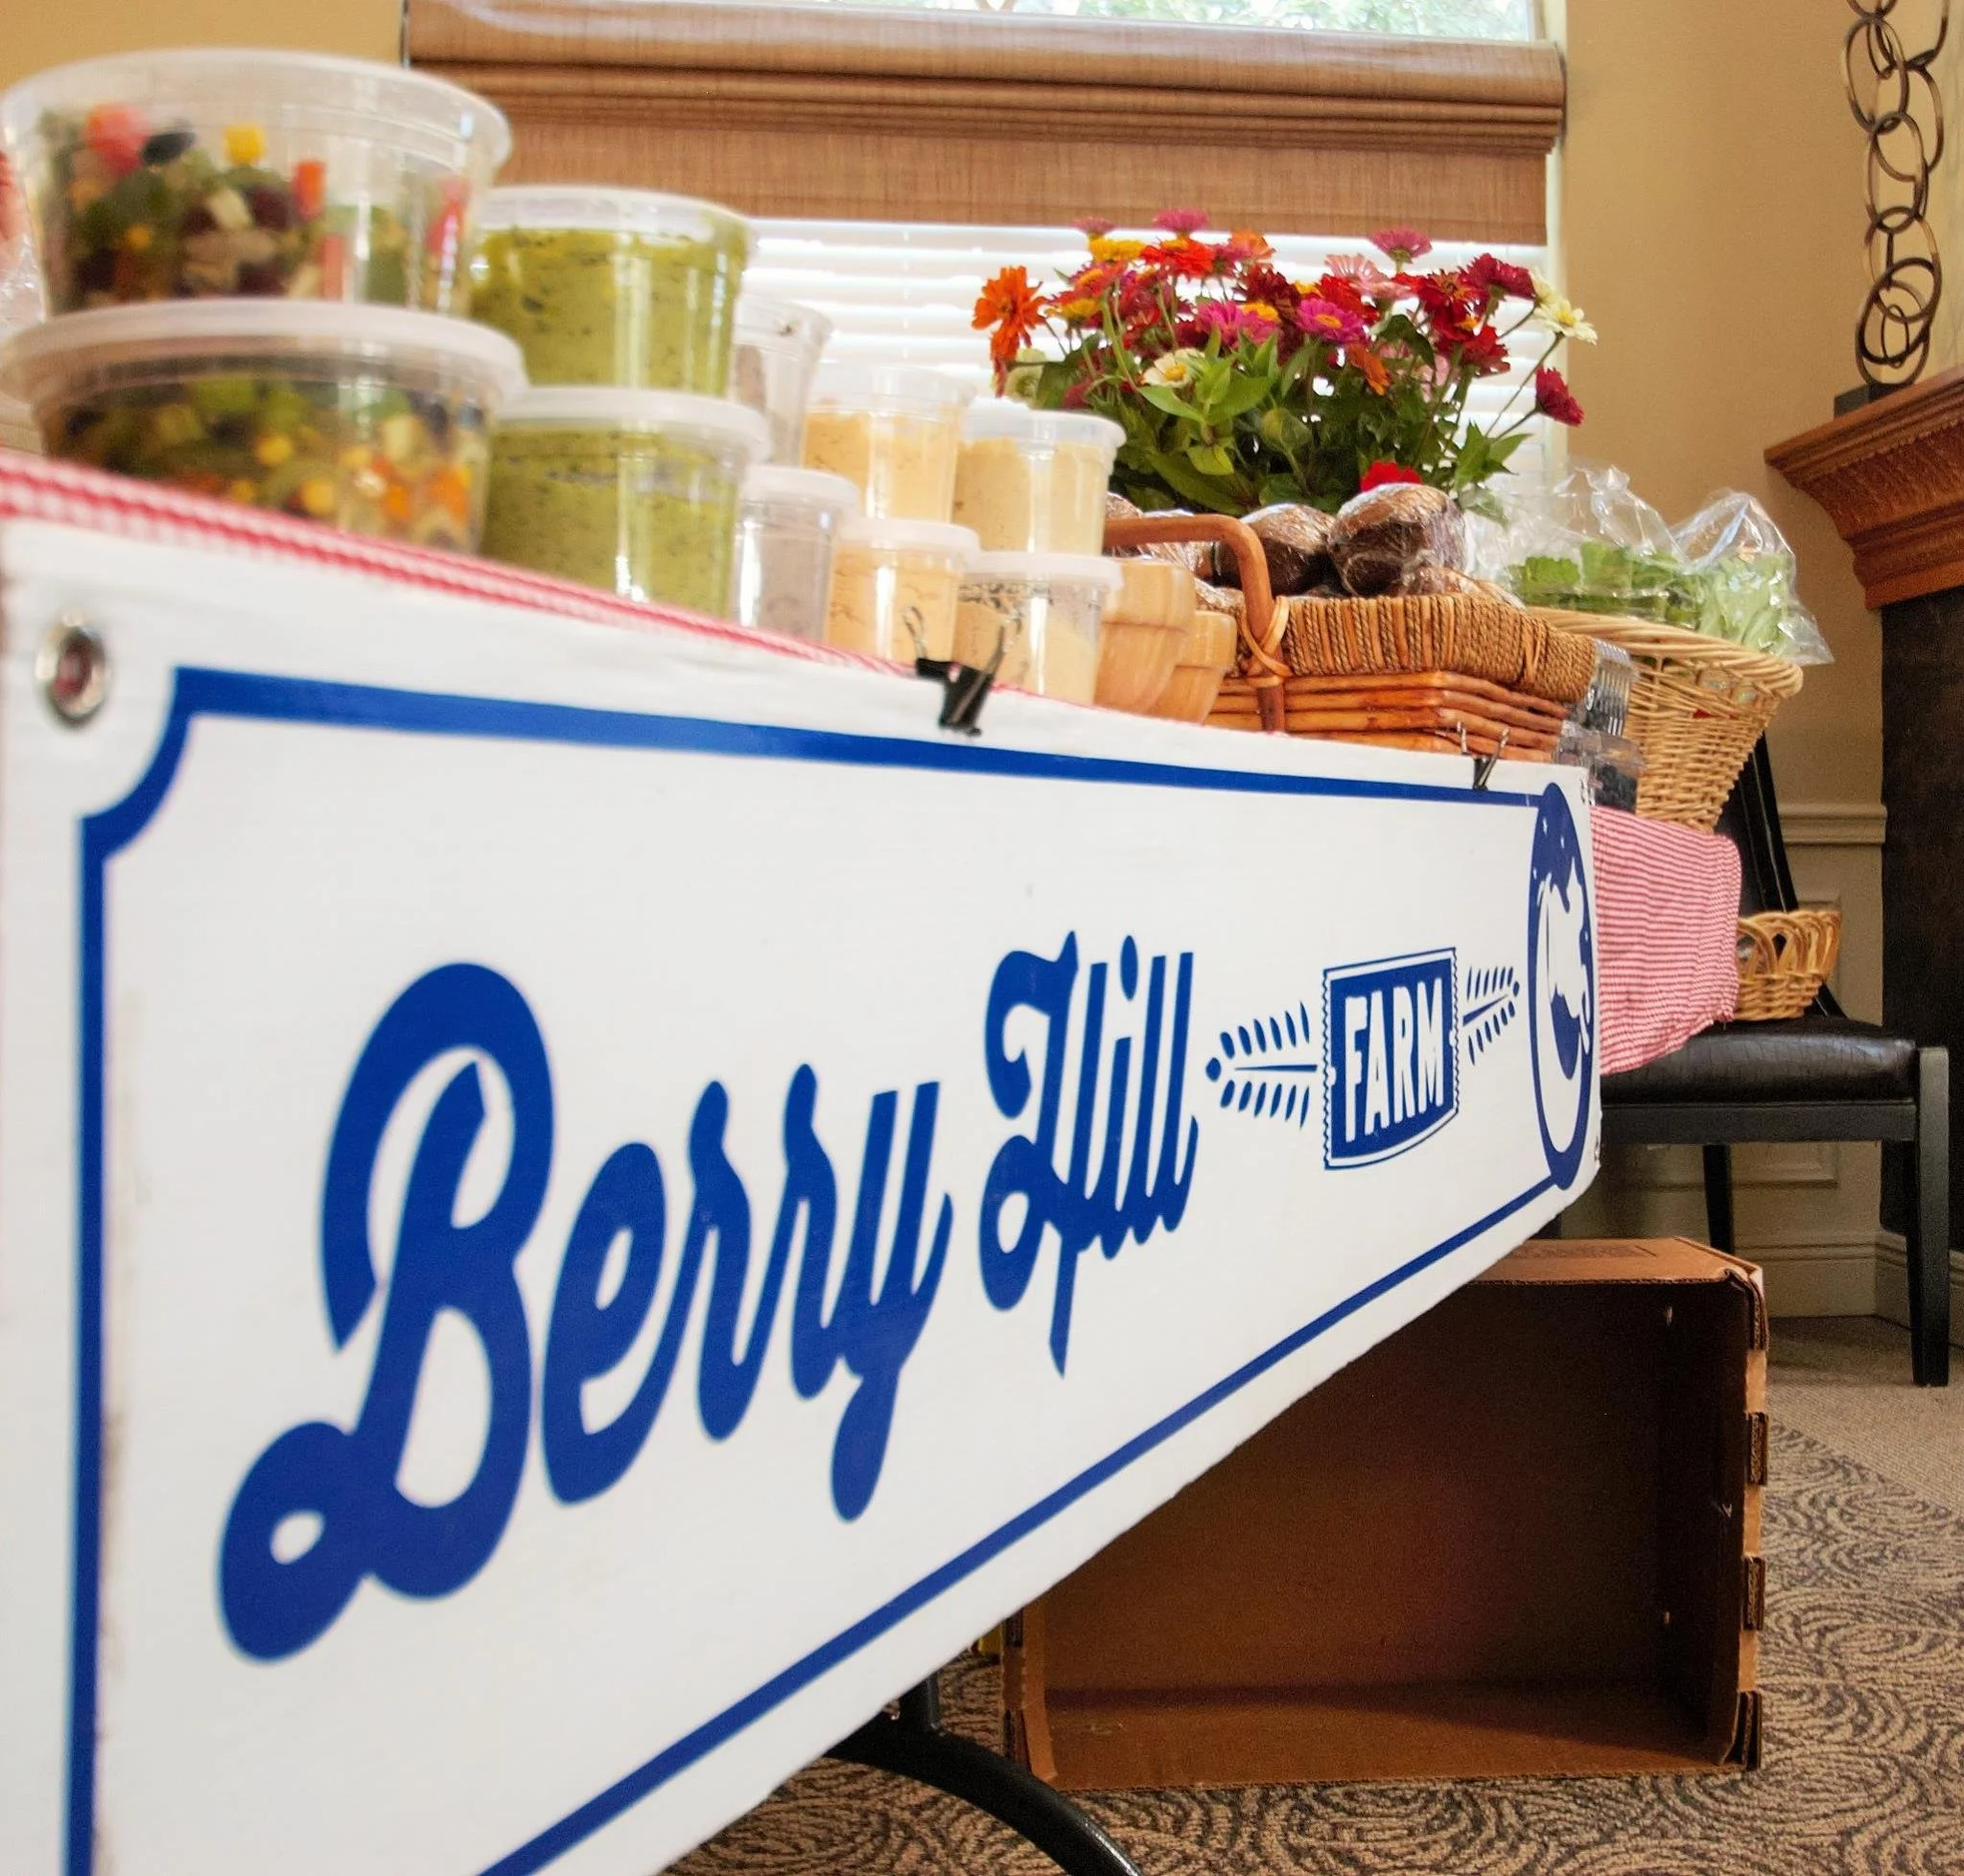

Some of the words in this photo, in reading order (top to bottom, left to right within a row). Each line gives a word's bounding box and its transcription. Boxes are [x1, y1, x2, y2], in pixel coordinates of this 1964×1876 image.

[218, 963, 952, 1663] Berry
[979, 930, 1198, 1378] Hill
[1344, 977, 1444, 1143] FARM
